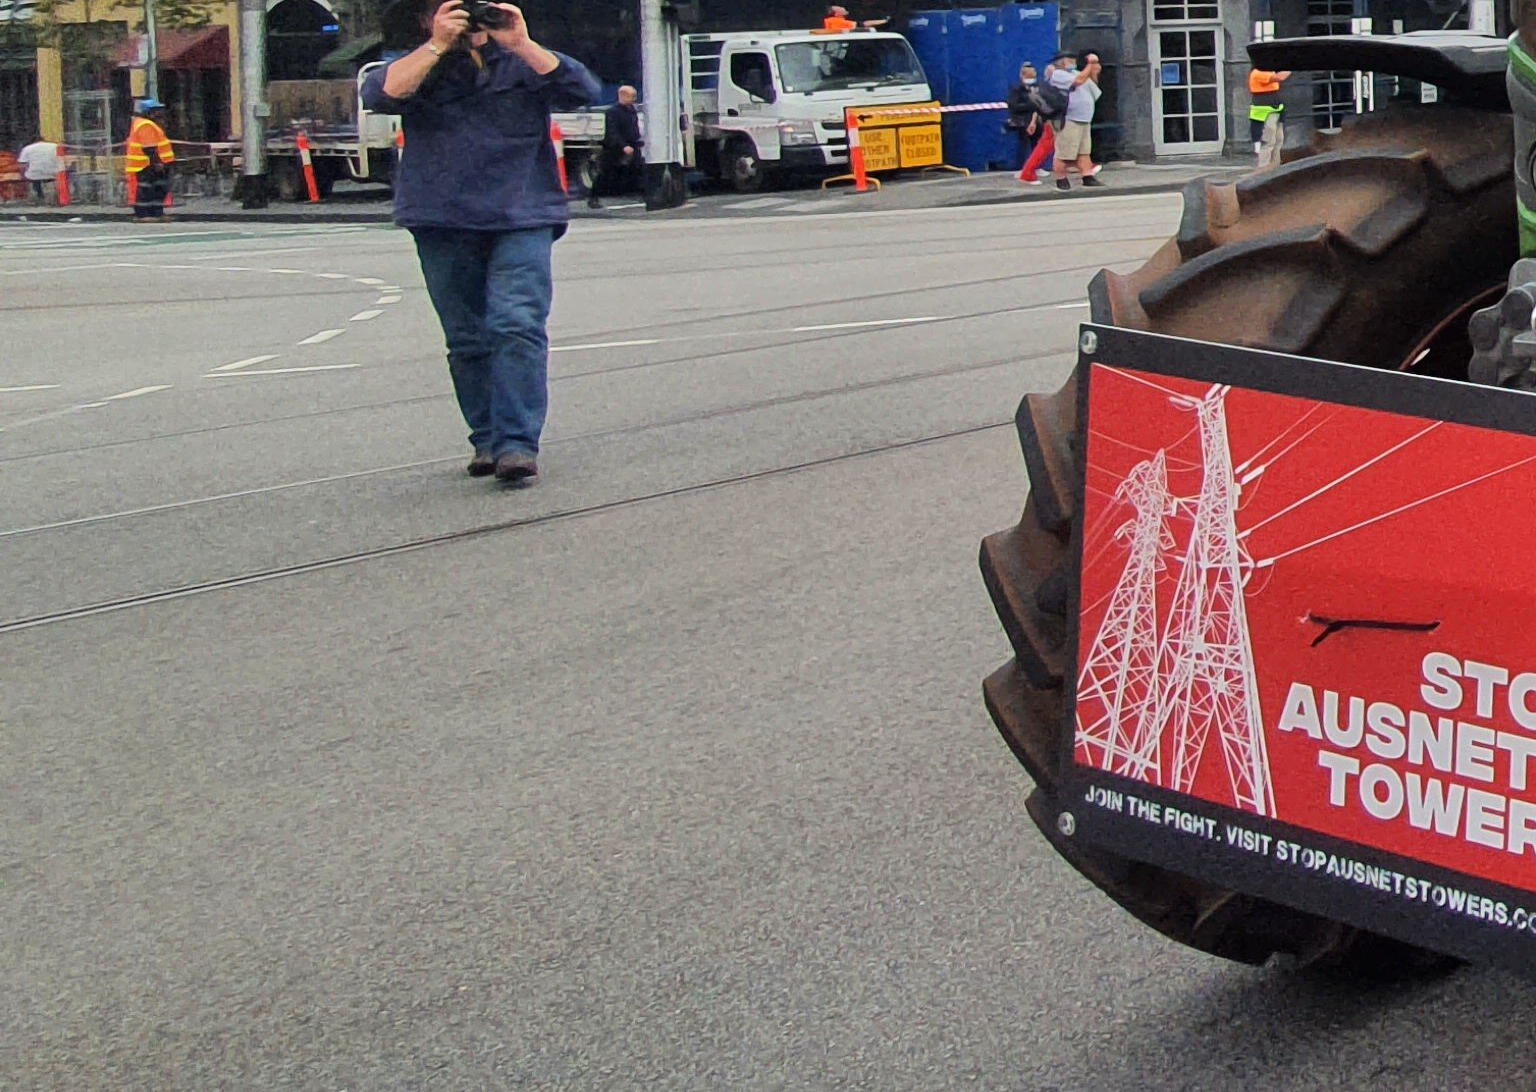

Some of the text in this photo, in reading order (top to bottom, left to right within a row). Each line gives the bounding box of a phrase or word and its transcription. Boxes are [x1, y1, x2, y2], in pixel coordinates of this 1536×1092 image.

[1085, 784, 1123, 813] JOIN
[1126, 795, 1162, 825] THE
[1163, 806, 1221, 843] FIGHT.
[1226, 824, 1273, 856] VISIT
